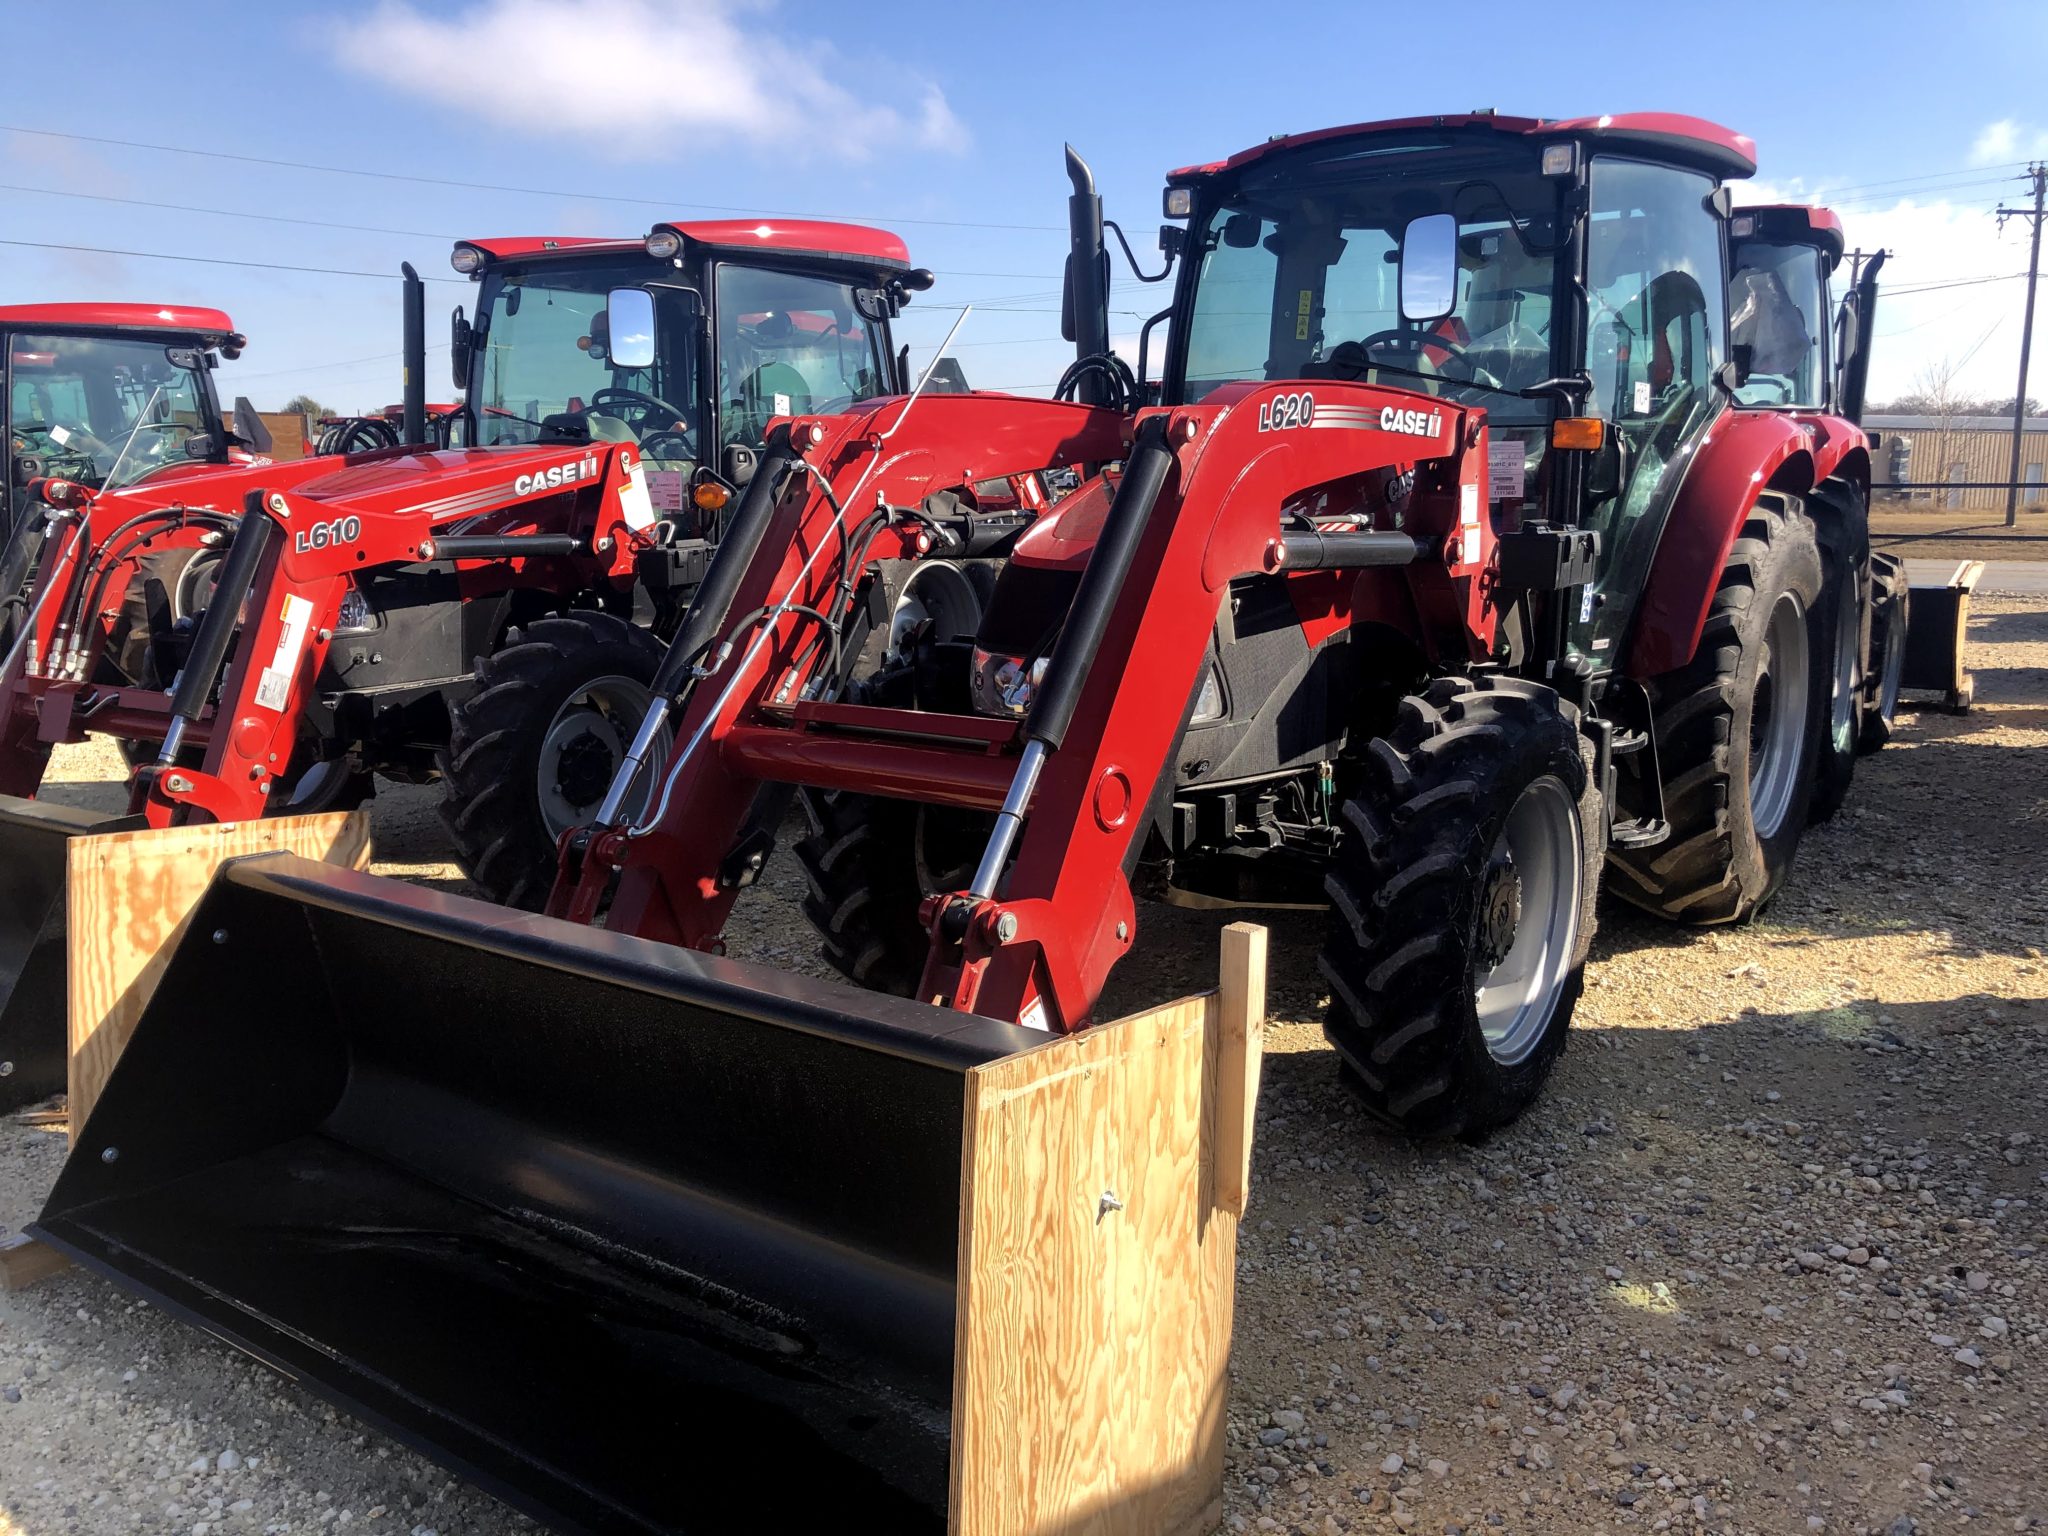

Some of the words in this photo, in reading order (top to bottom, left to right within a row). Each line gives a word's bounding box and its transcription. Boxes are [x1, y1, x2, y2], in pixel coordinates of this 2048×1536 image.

[1258, 392, 1314, 432] L620
[1380, 406, 1427, 436] CASE
[513, 461, 577, 496] CASE
[1389, 469, 1415, 501] CAS
[295, 515, 361, 555] L610
